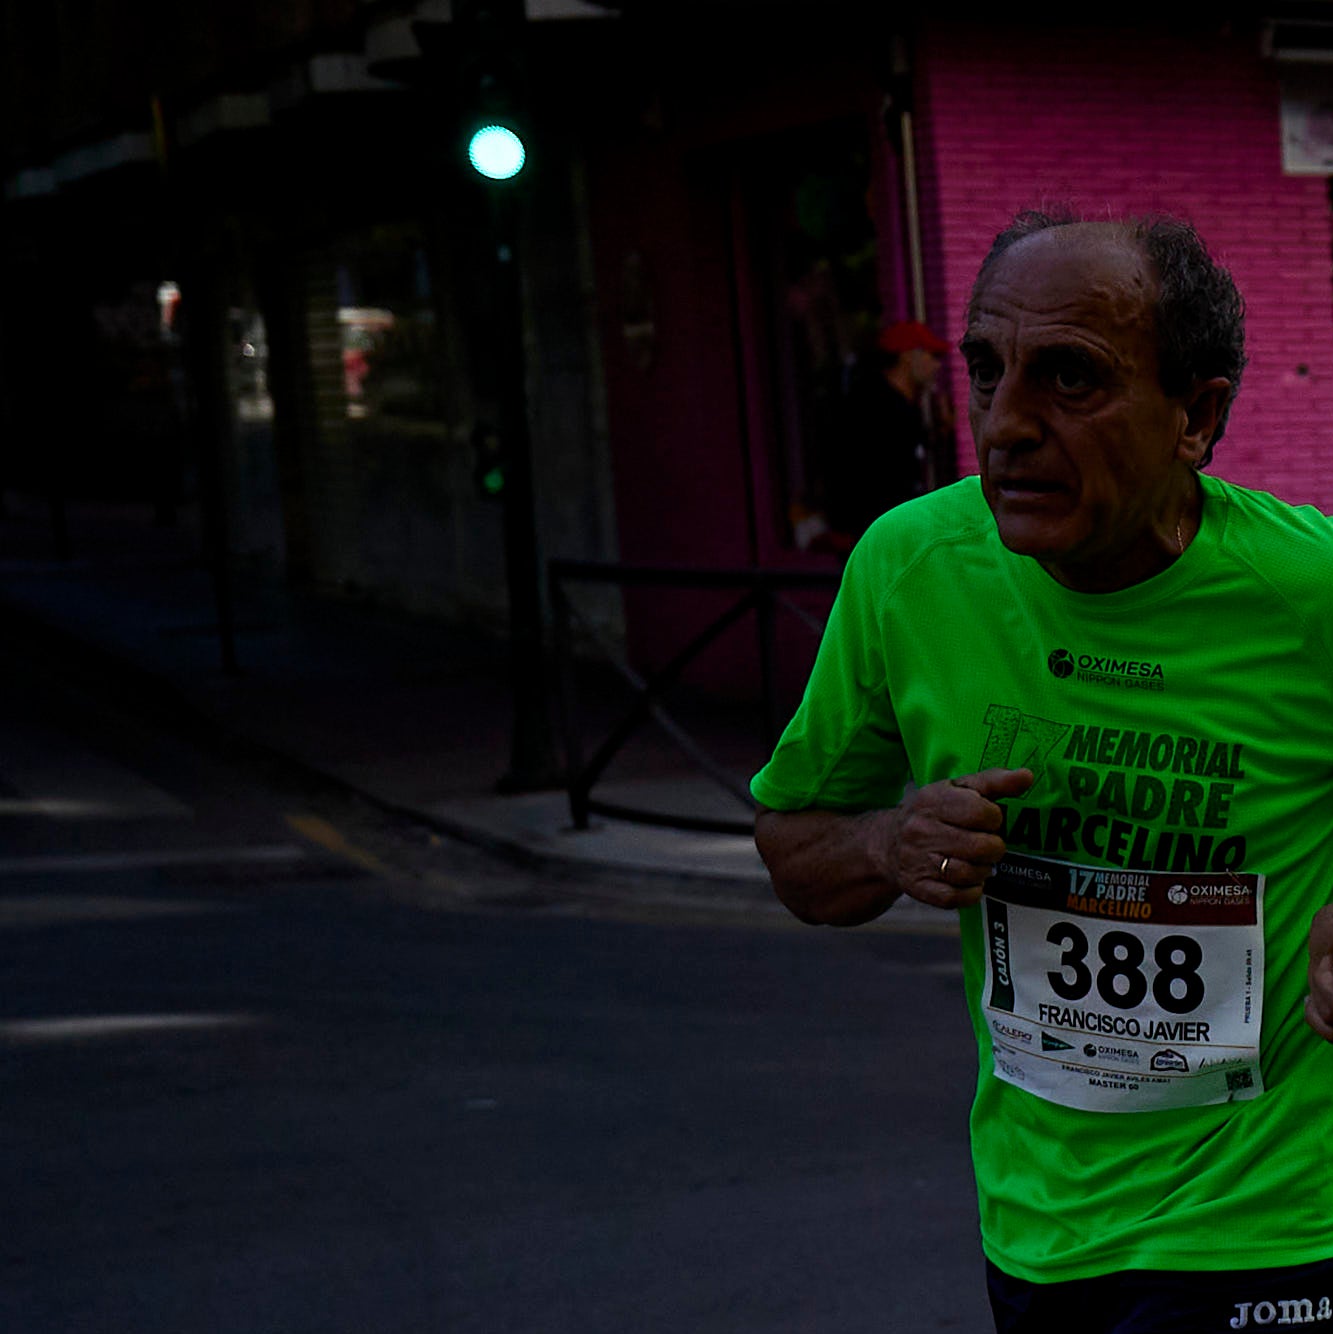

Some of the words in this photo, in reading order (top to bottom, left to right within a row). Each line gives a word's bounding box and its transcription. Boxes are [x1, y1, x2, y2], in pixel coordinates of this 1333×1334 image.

[1077, 654, 1164, 679] OXIMESA
[1076, 672, 1122, 688] NIPPON
[1124, 677, 1166, 692] GASES
[1062, 723, 1246, 780] MEMORIAL
[1067, 765, 1235, 830] PADRE
[1068, 867, 1096, 897] 17
[1094, 871, 1151, 887] MEMORIAL
[1189, 884, 1250, 896] OXIMESA
[1095, 883, 1147, 902] PADRE
[1065, 893, 1153, 920] MARCELINO
[993, 921, 1006, 933] 3
[992, 936, 1010, 987] CAJÓN
[1046, 921, 1205, 1015] 388
[1039, 1003, 1140, 1037] FRANCISCO
[1143, 1020, 1211, 1042] JAVIER
[1097, 1045, 1140, 1058] OXIMESA
[1088, 1078, 1127, 1090] MASTER
